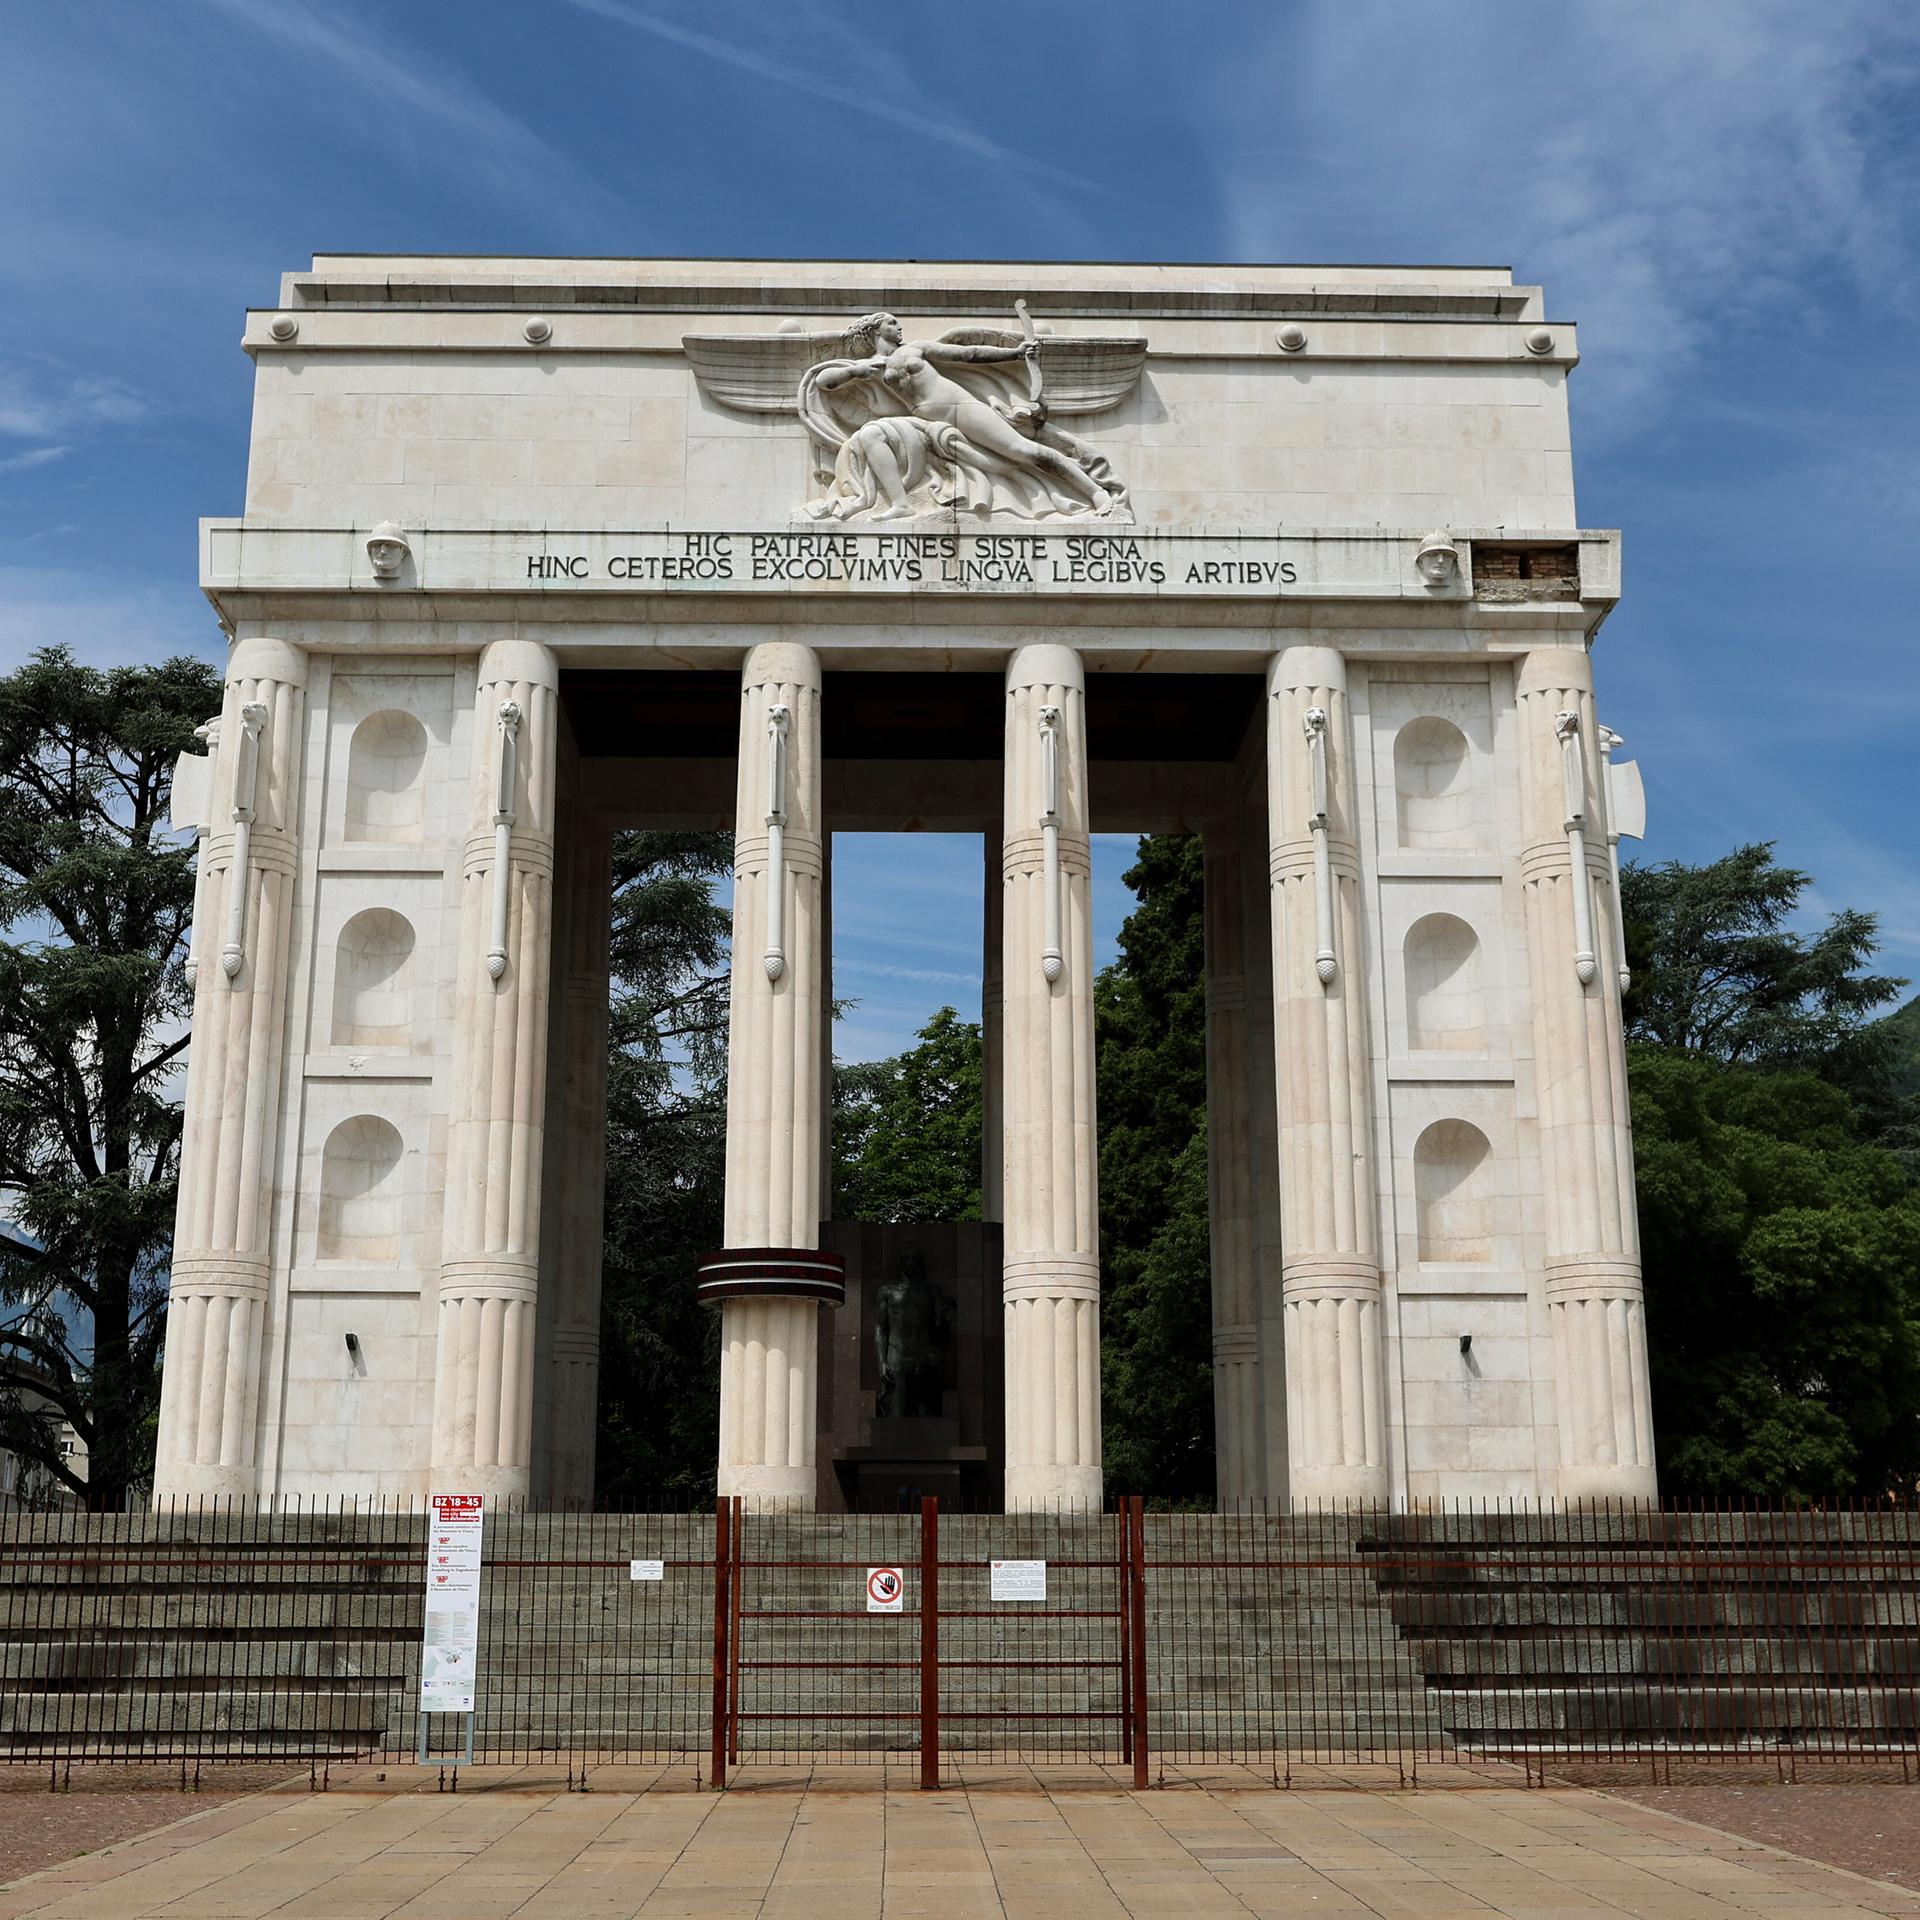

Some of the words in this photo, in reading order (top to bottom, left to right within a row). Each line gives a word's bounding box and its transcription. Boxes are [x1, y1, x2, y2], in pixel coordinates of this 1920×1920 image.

[684, 534, 733, 557] HIC
[750, 535, 859, 558] PATRIAE
[877, 536, 956, 559] FINES
[975, 537, 1048, 560] SISTE
[1066, 538, 1142, 560] SIGNA
[527, 556, 589, 579] HINC
[607, 556, 733, 579] CETEROS
[751, 558, 922, 581] EXCOLVIMVS
[941, 559, 1034, 582] LINGVA
[1052, 560, 1166, 584] LEGIBVS
[1184, 561, 1298, 584] ARTIBVS
[435, 1497, 447, 1506] BZ
